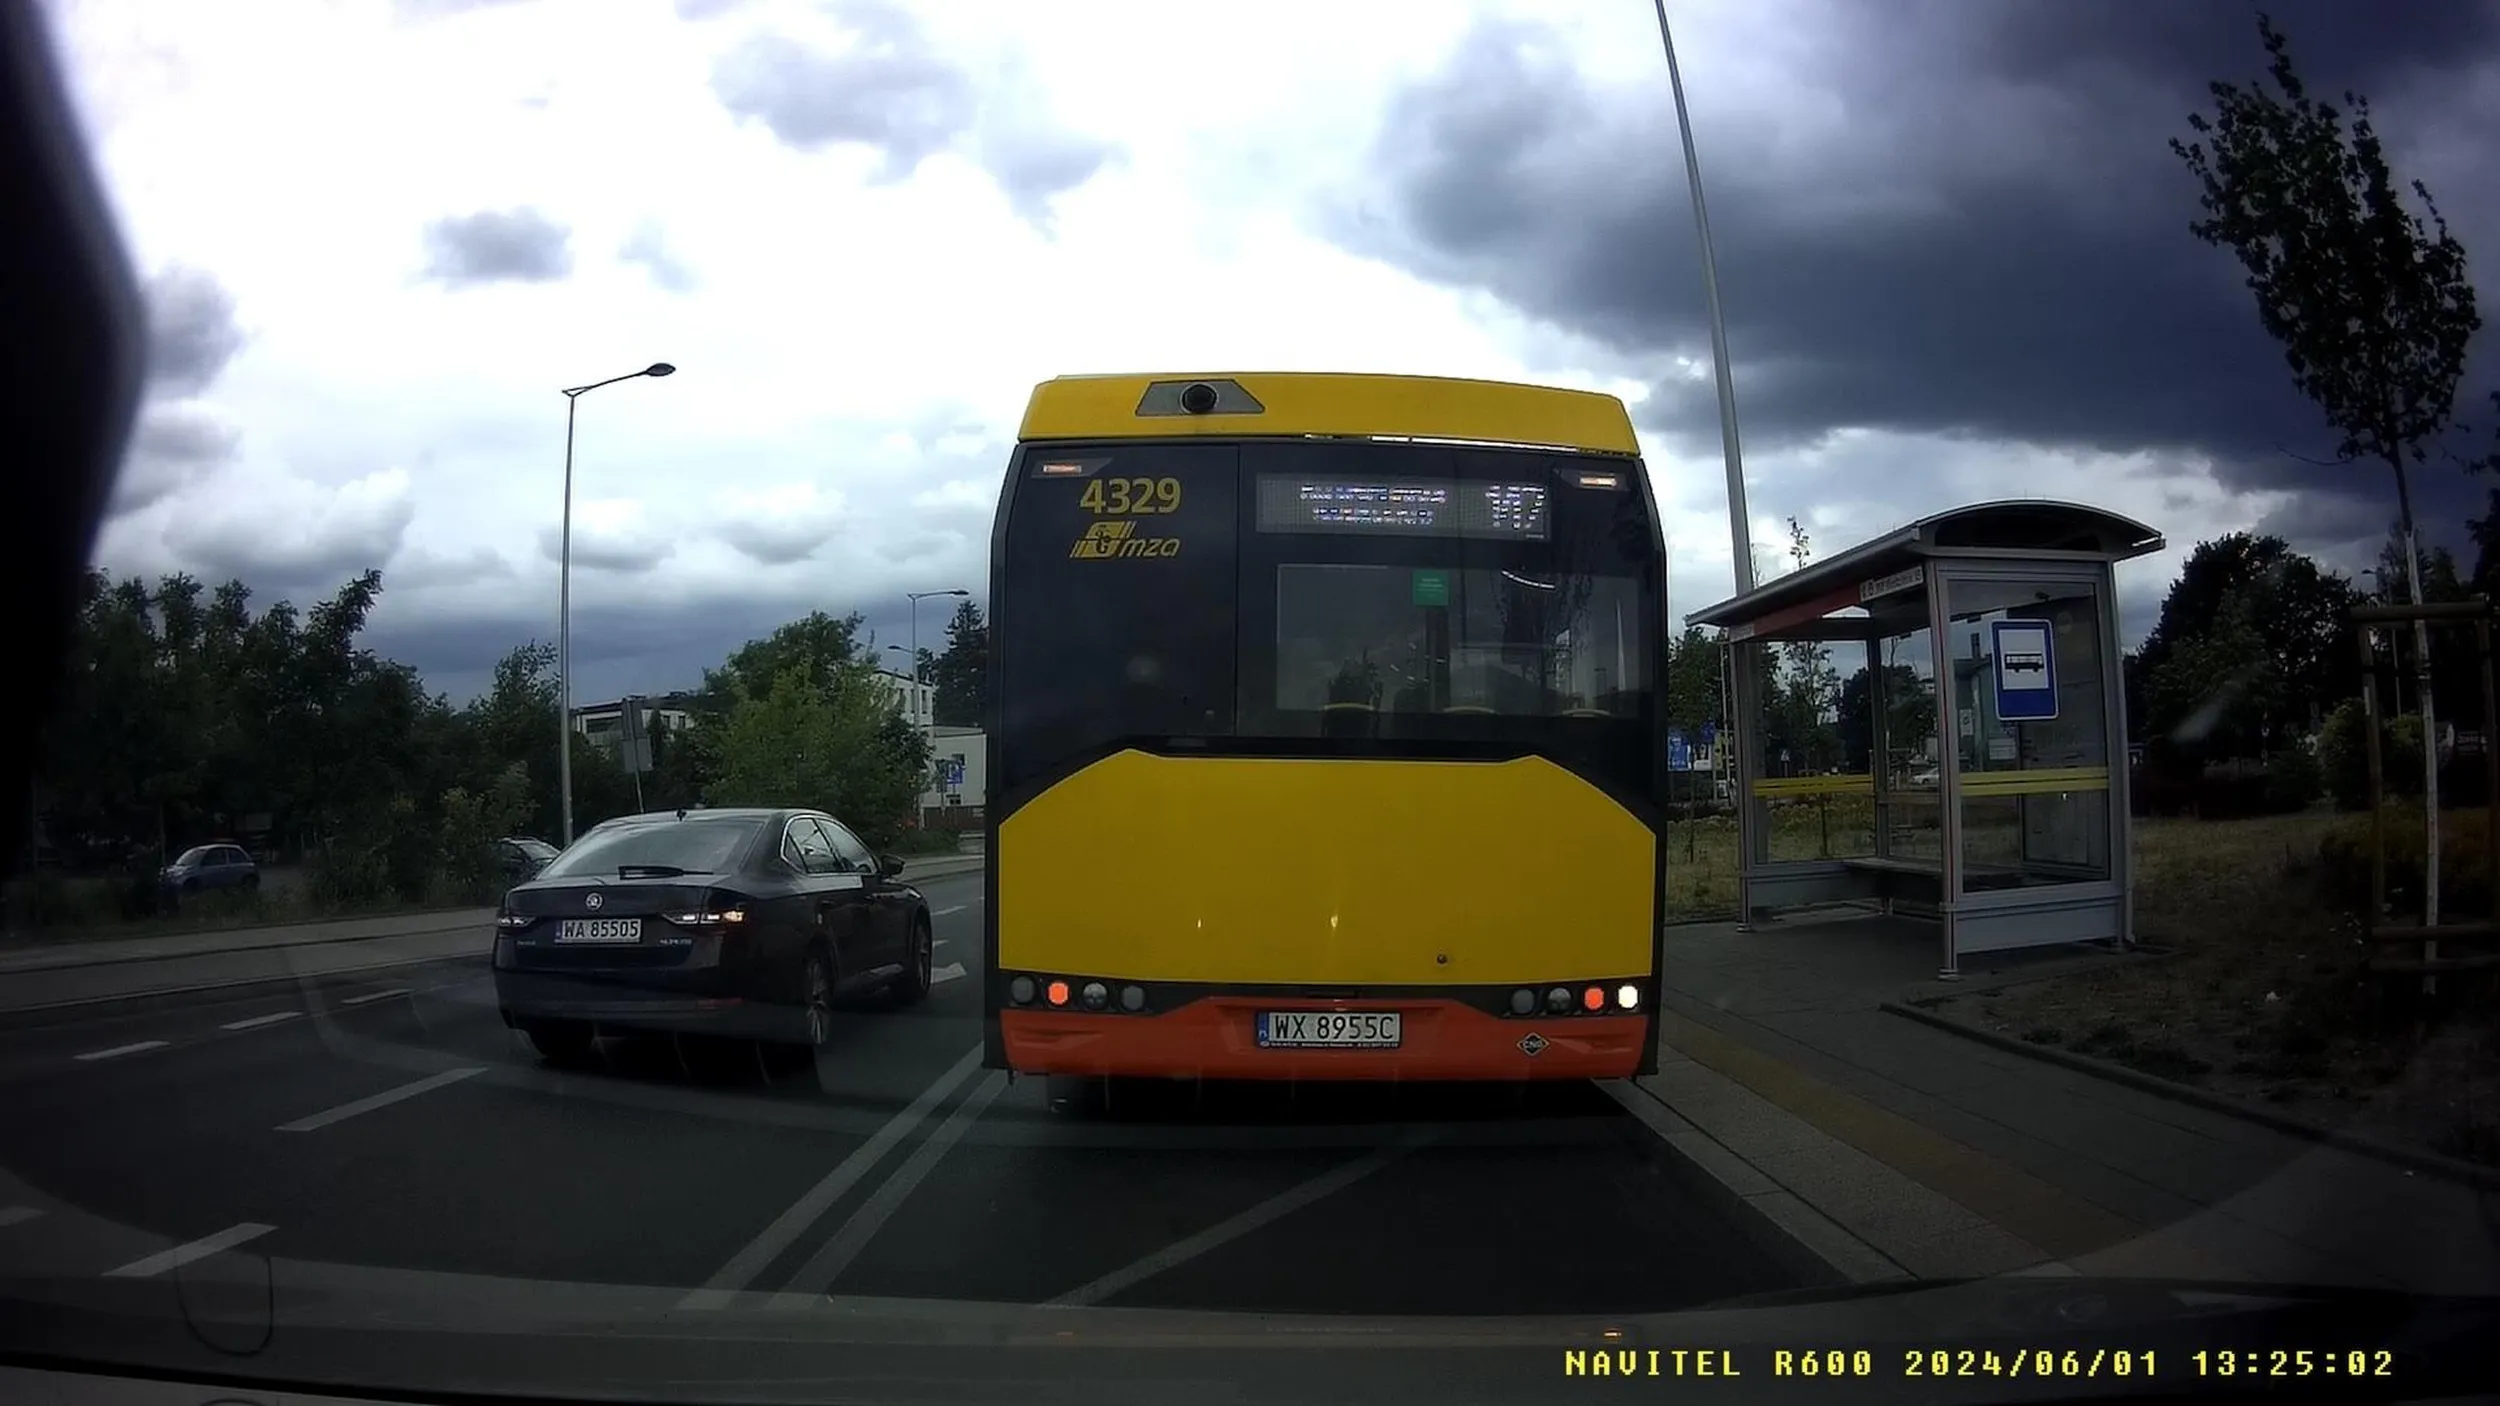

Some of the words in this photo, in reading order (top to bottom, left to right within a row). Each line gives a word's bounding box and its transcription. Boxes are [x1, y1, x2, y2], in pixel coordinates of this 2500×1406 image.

[1080, 477, 1182, 514] 4329
[1118, 537, 1182, 559] mza
[563, 921, 586, 938] WA
[590, 921, 640, 938] 85505
[1274, 1015, 1307, 1039] WX
[1316, 1015, 1394, 1040] 8955C
